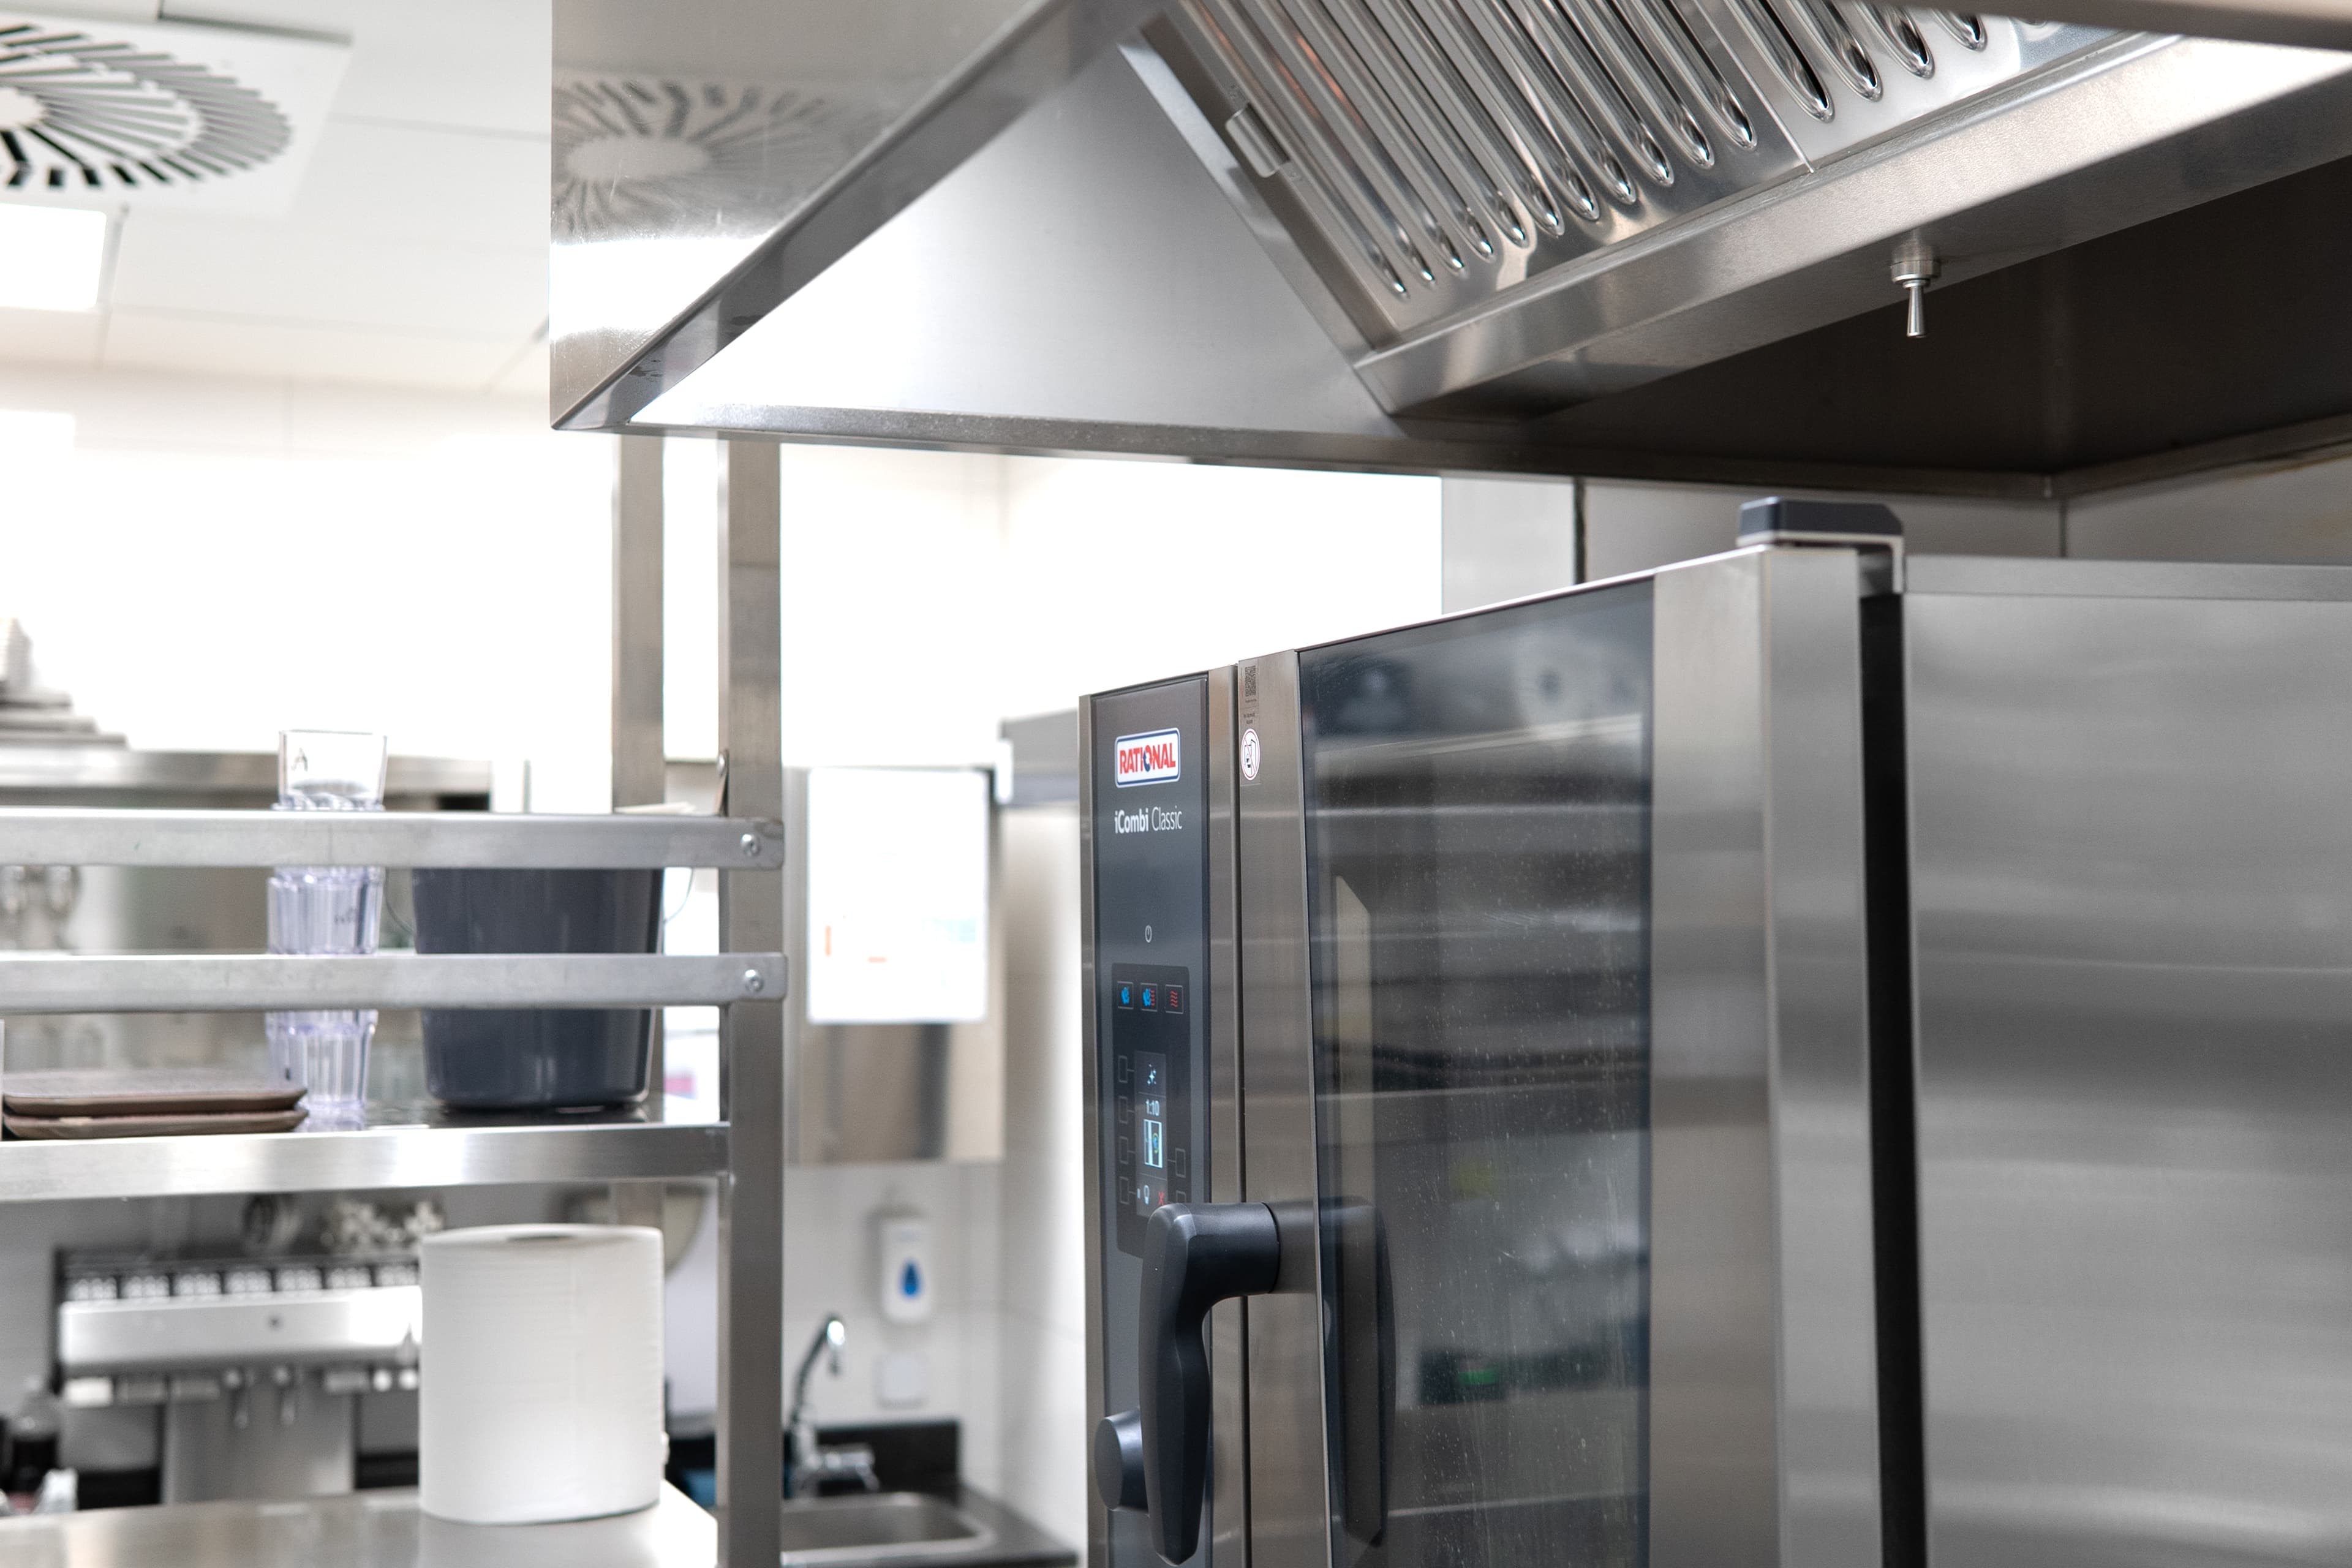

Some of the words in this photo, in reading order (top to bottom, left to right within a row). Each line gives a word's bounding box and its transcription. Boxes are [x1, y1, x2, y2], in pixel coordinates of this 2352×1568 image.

[1120, 742, 1176, 774] RATIONAL
[1114, 807, 1149, 834] iCombi
[1152, 805, 1183, 831] Classic
[1145, 1099, 1160, 1116] 1:10
